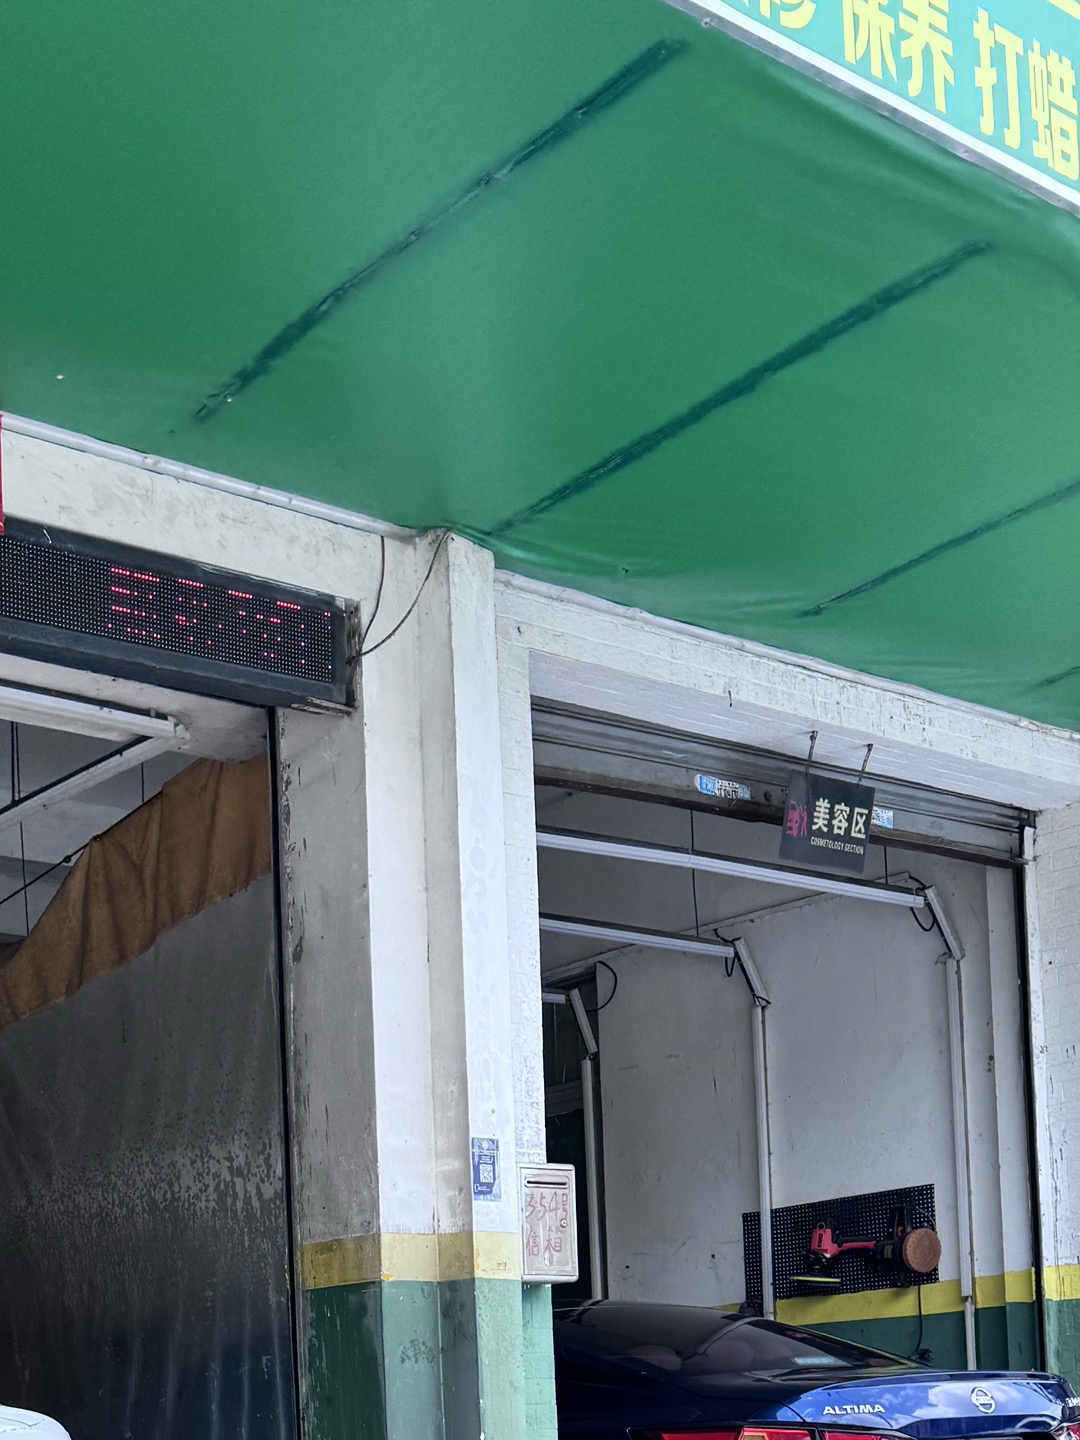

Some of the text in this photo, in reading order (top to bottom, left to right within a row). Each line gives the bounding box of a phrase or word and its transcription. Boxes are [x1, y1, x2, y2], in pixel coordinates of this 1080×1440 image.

[973, 7, 1080, 181] 打蜡
[811, 797, 869, 840] 美容区
[810, 836, 865, 855] COSMETOLOGY SECTION
[525, 1224, 563, 1257] 信箱
[822, 1403, 886, 1416] ALTIMA
